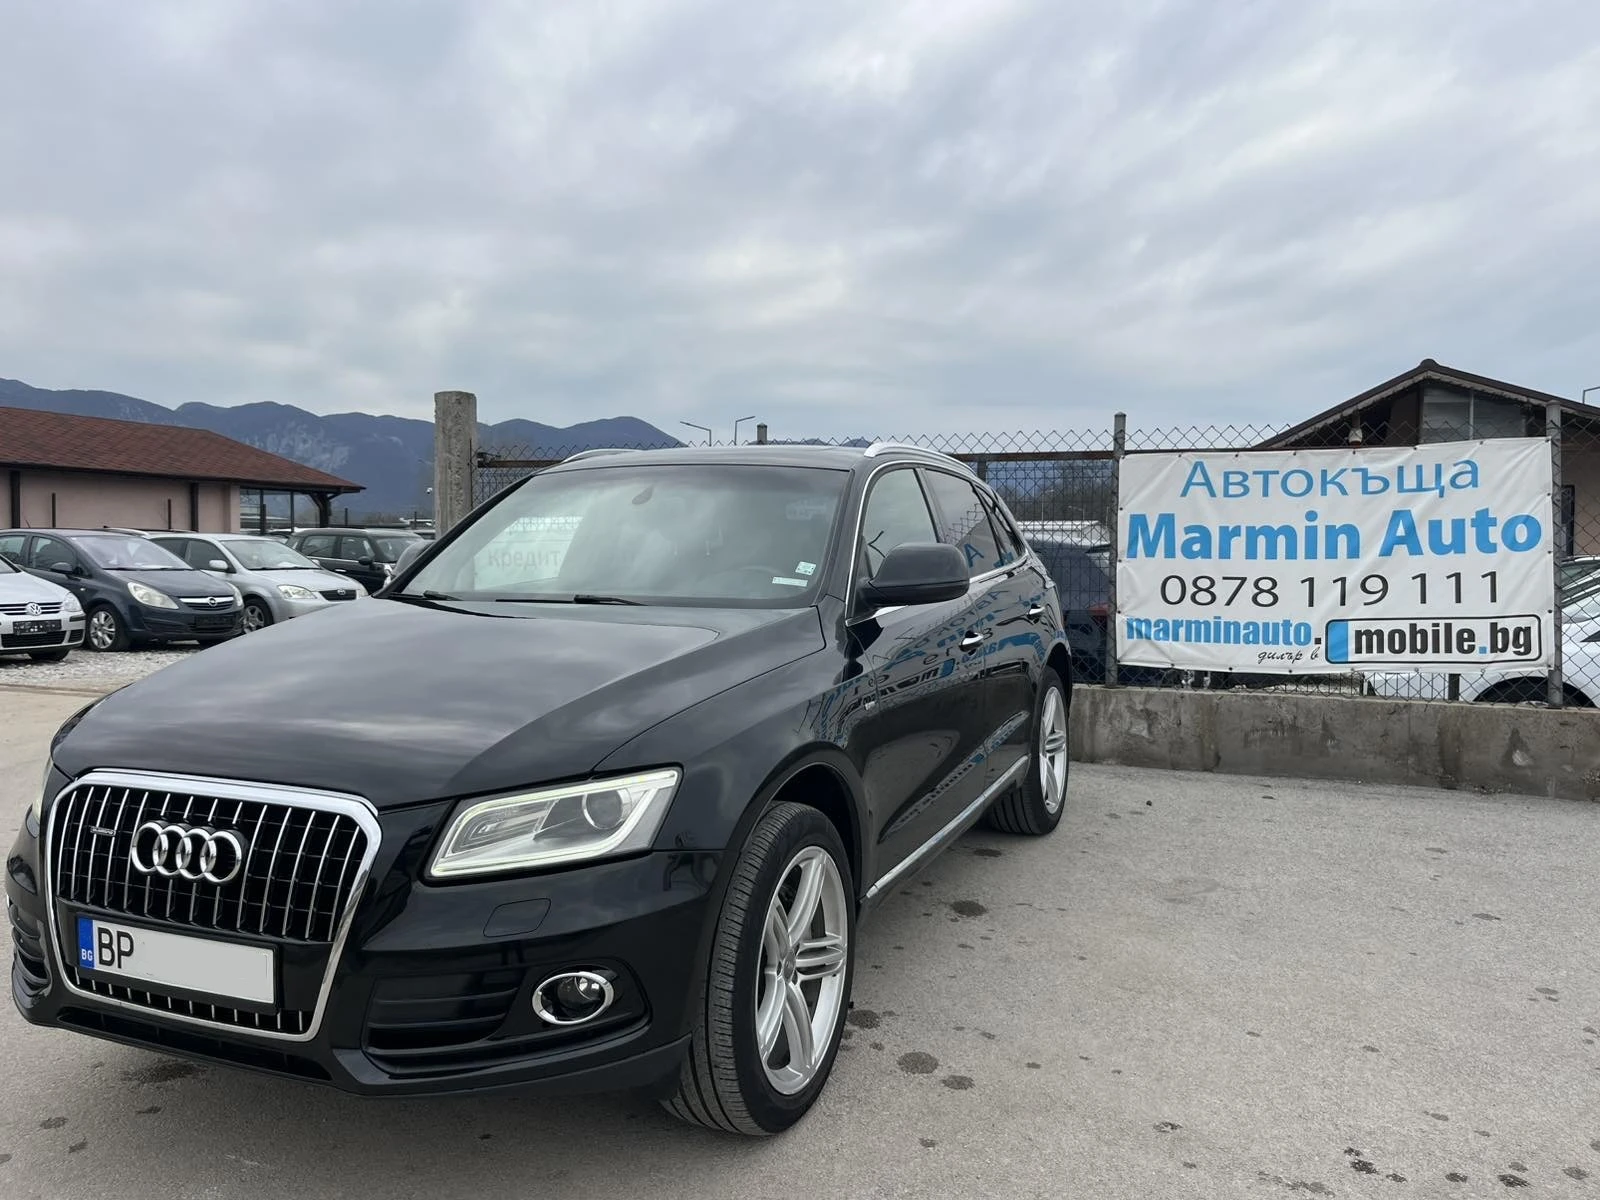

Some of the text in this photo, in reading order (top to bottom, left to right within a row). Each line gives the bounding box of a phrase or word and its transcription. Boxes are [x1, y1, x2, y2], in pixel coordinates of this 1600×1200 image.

[1179, 459, 1479, 498] Автокъща
[1126, 507, 1542, 560] Marmin Auto
[1160, 571, 1497, 608] 0878 119 111
[1354, 622, 1532, 656] mobile.bg
[81, 948, 93, 961] BG
